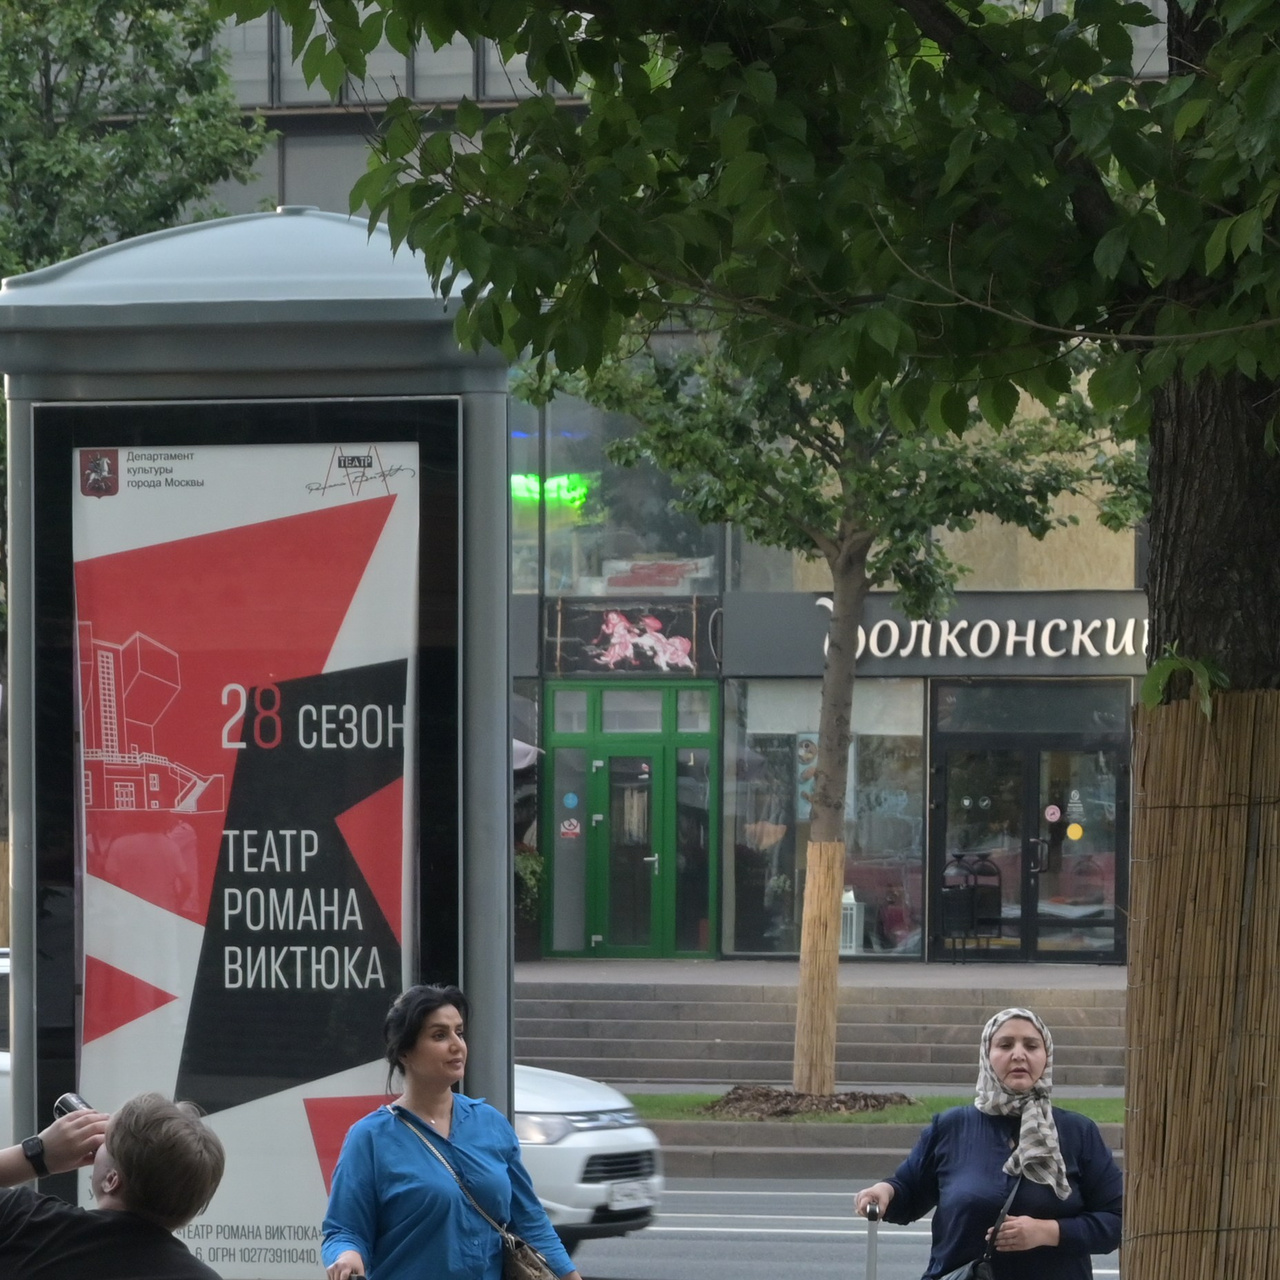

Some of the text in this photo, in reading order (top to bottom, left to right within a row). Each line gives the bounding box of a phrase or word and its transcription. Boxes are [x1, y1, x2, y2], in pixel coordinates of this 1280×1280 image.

[126, 451, 195, 463] Департамент
[339, 456, 372, 468] ТЕАТР
[126, 465, 174, 476] культуры
[126, 477, 205, 489] города Москвы
[815, 597, 1148, 659] олконски
[221, 683, 406, 749] 28 СЕЗОН
[222, 829, 319, 872] ТЕАТР
[224, 888, 363, 931] РОМАНА
[224, 945, 386, 989] ВИКТЮКА
[216, 1224, 262, 1240] РОМАНА
[208, 1247, 236, 1262] ОГРН
[239, 1247, 319, 1266] 1027739110410,
